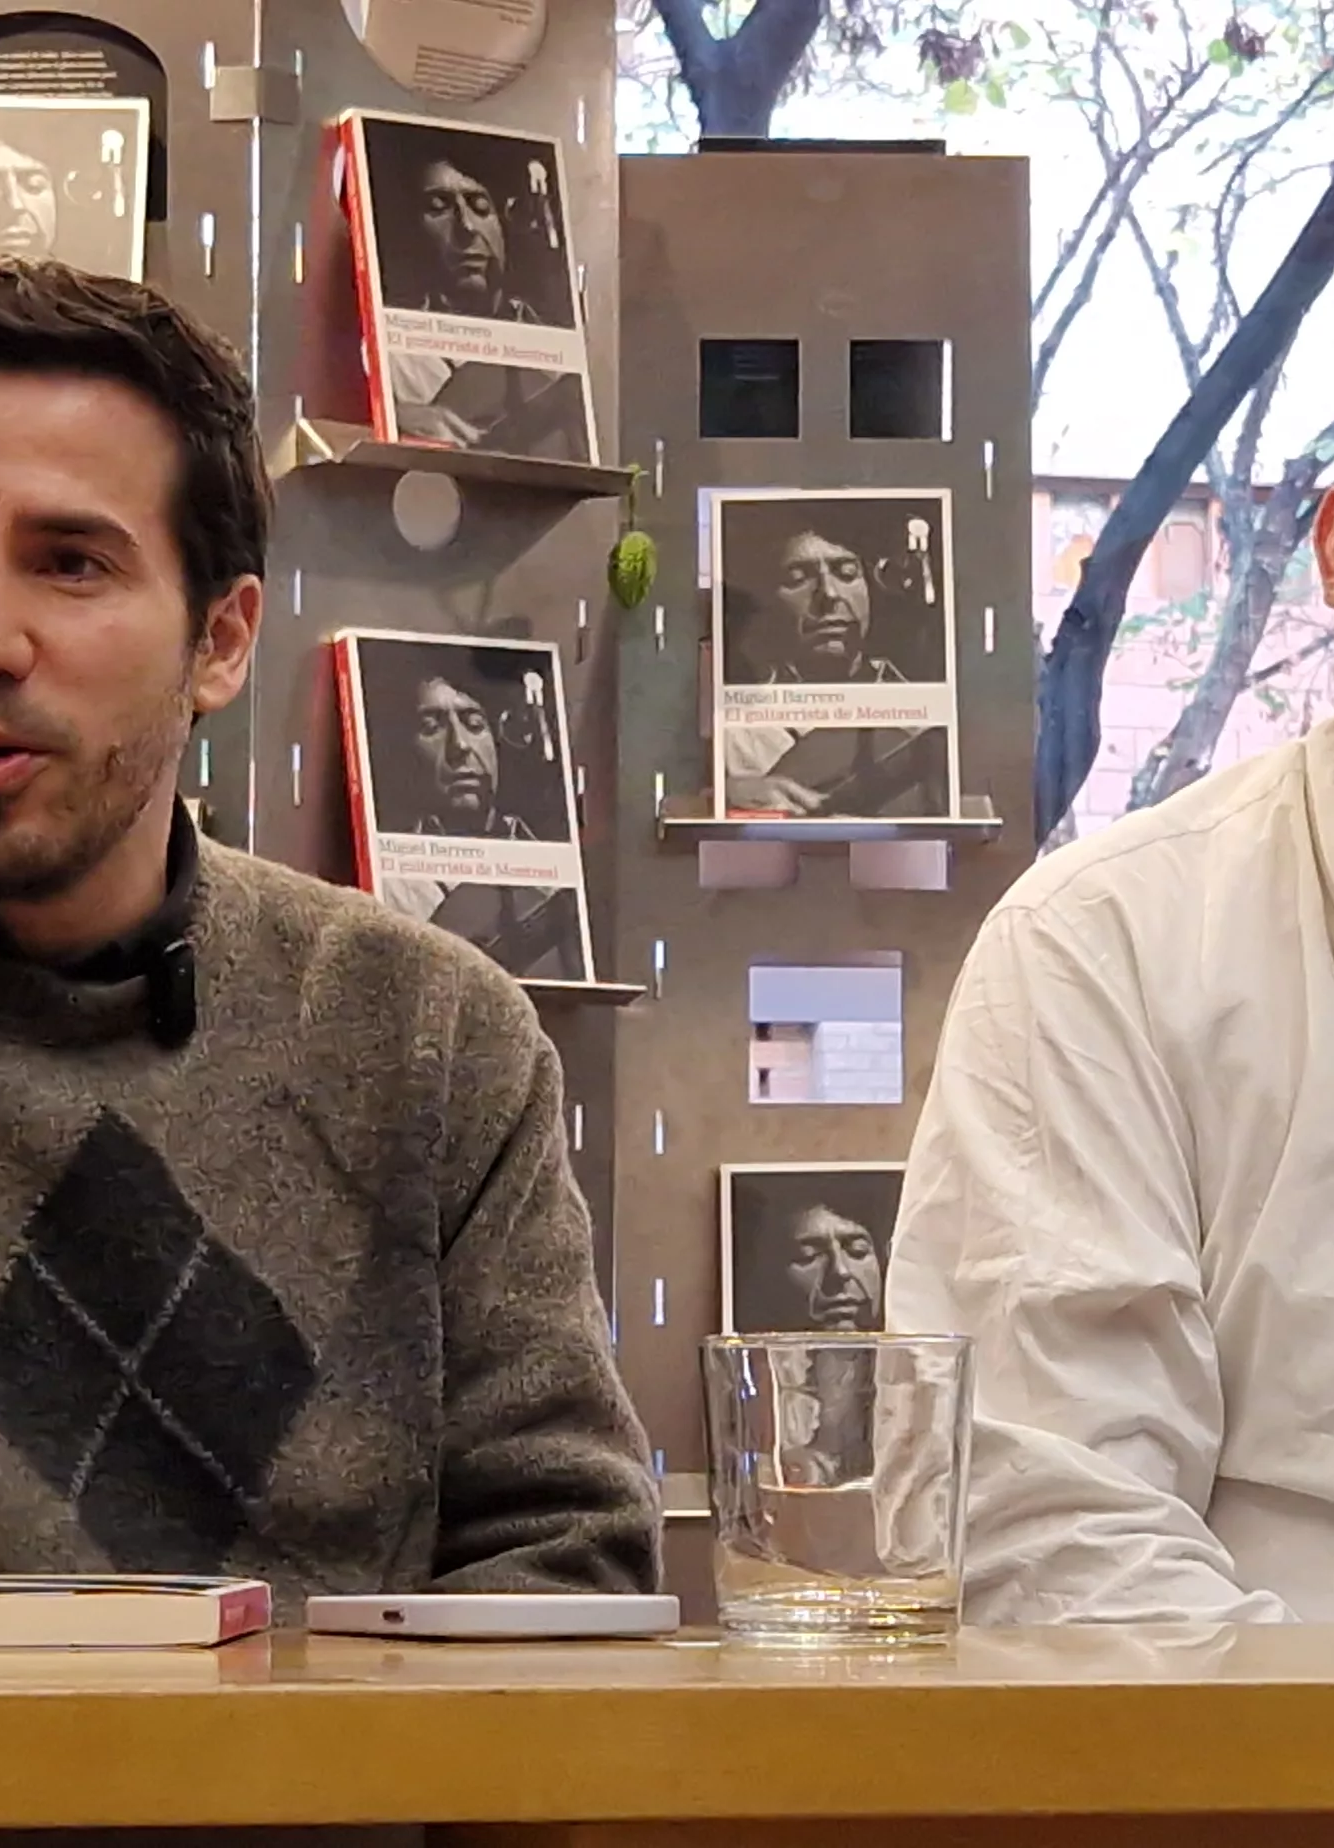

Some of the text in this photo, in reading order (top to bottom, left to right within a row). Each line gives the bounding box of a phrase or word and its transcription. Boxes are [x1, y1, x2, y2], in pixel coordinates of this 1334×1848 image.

[724, 690, 845, 706] Miguel Barrero
[724, 706, 928, 724] El guitarrista de Montreal
